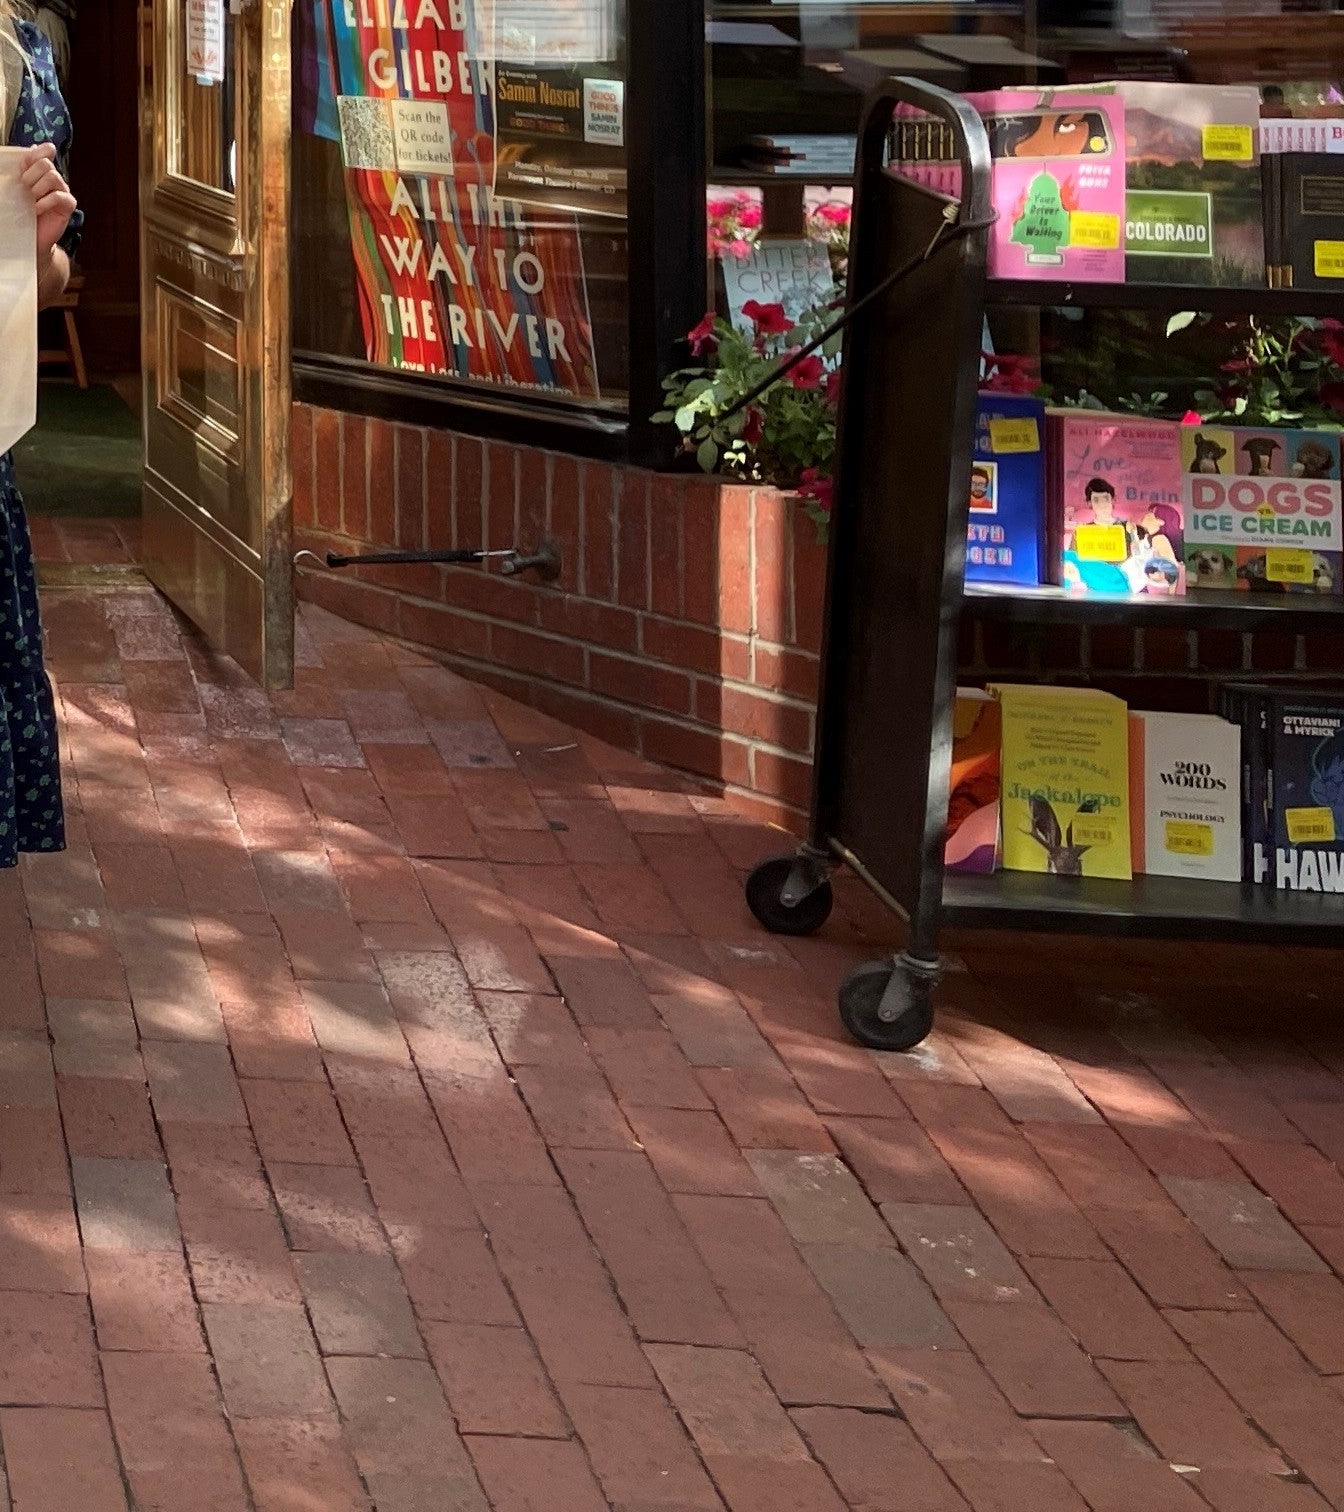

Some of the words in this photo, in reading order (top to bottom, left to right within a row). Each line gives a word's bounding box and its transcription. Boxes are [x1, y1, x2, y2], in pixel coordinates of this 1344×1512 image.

[368, 48, 494, 95] GILBER
[498, 76, 537, 103] Samin
[539, 80, 580, 108] Nosrat
[398, 109, 423, 123] Scan
[425, 110, 442, 124] the
[400, 128, 418, 143] QR
[421, 131, 444, 143] code
[389, 176, 454, 223] ALL
[1025, 226, 1063, 240] Waiting
[1125, 221, 1207, 244] COLORADO
[379, 234, 476, 287] WAY
[492, 248, 545, 295] TO
[737, 270, 824, 294] CREEK
[380, 293, 437, 342] THE
[448, 303, 573, 364] RIVER
[1125, 486, 1179, 503] Brain
[1192, 477, 1334, 517] DOGS
[1193, 514, 1233, 532] ICE
[1241, 516, 1332, 538] CREAM
[1283, 715, 1341, 728] OTTAVIANI
[1174, 760, 1212, 777] 200
[1159, 773, 1227, 791] WORDS
[1275, 847, 1344, 894] HAW
